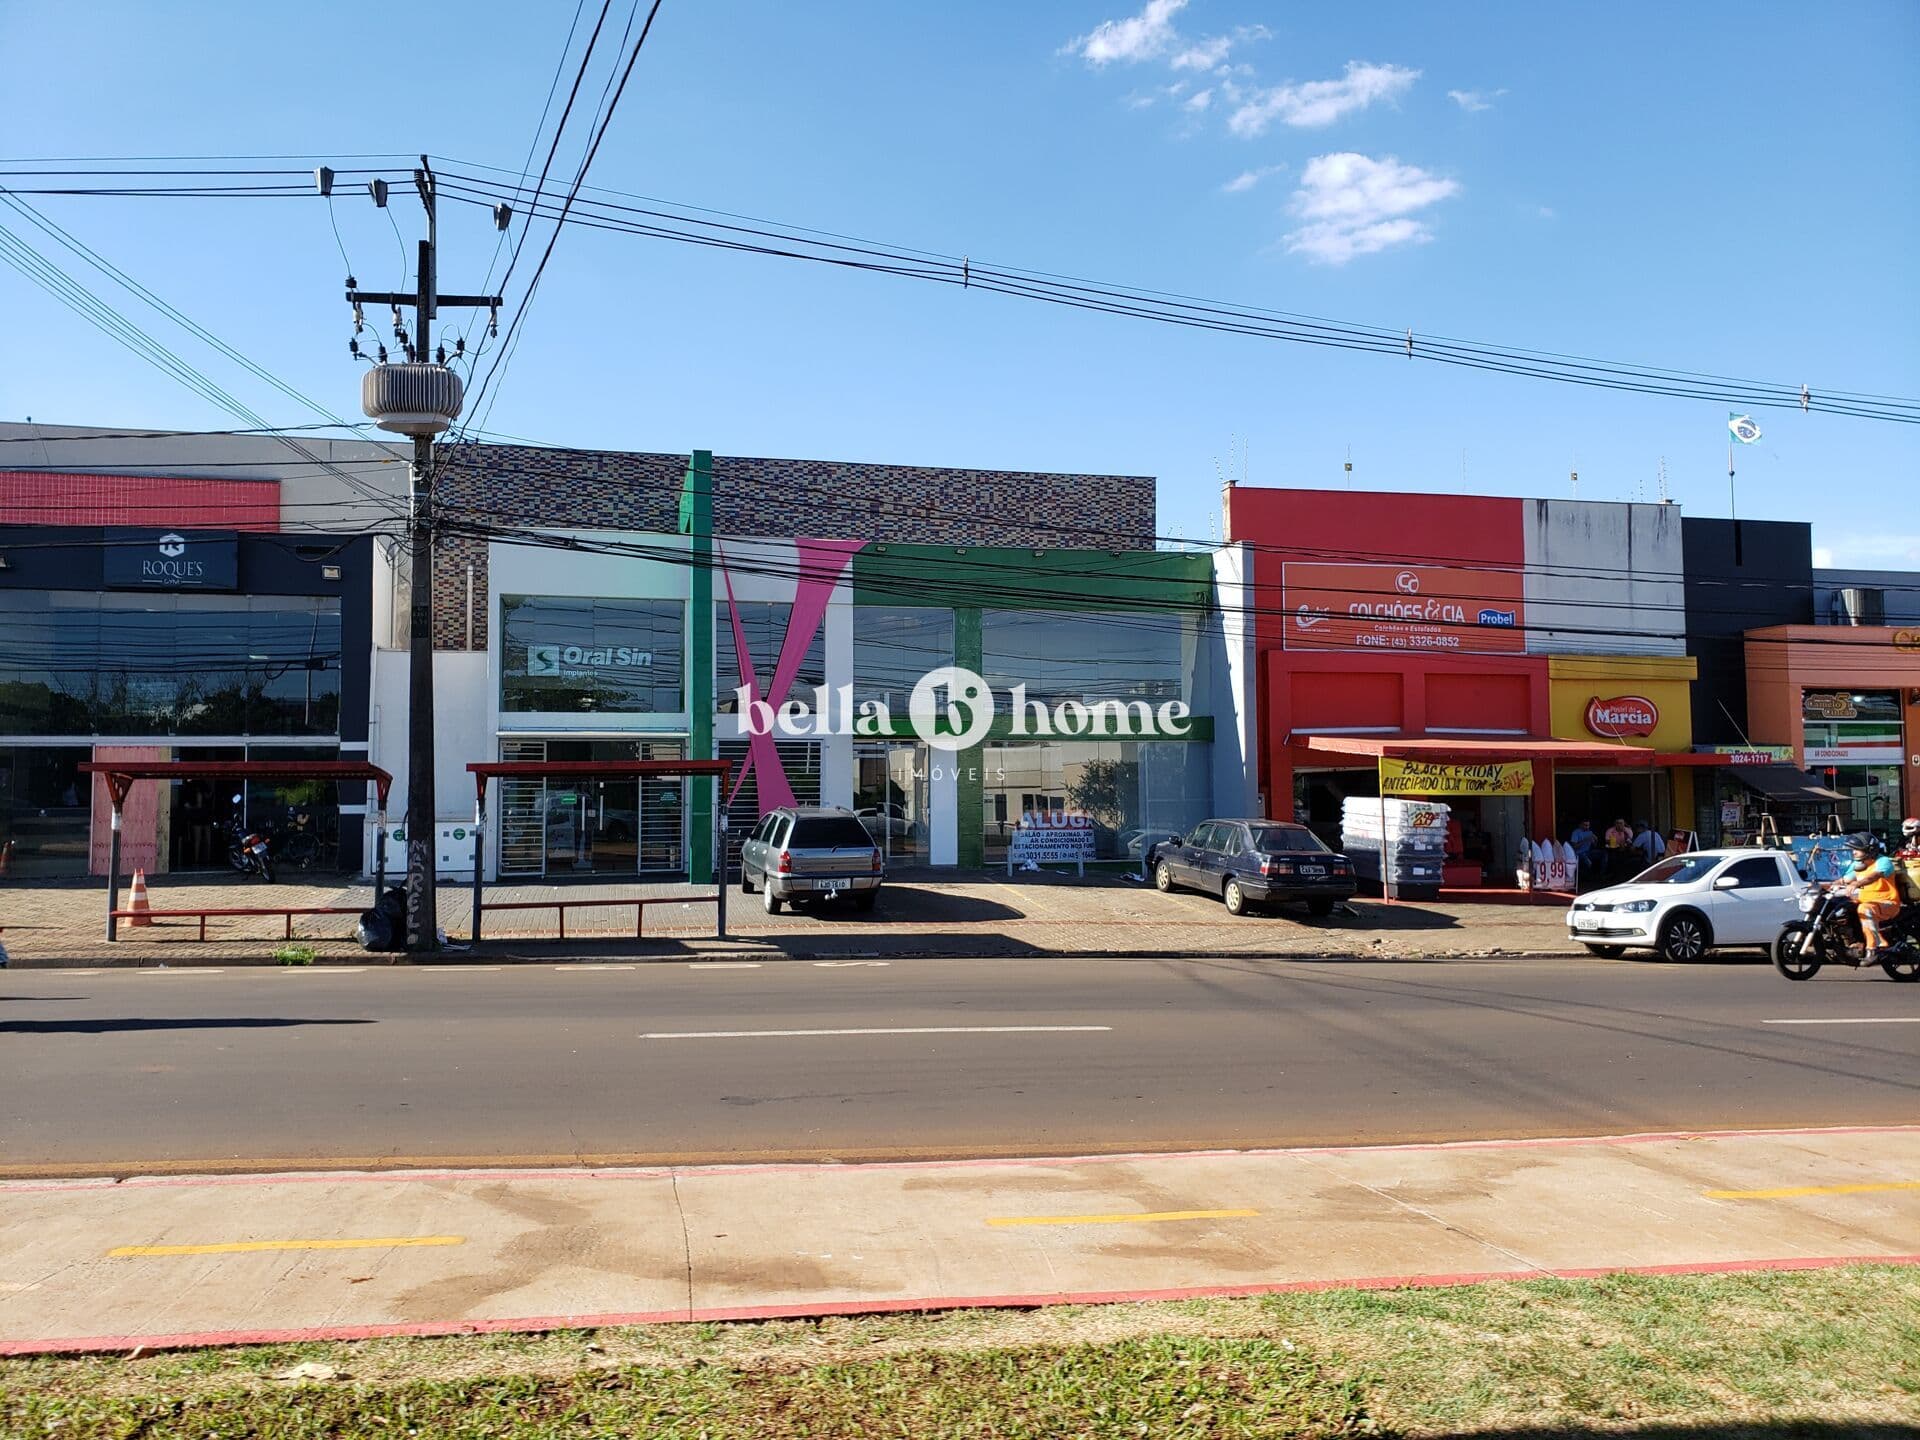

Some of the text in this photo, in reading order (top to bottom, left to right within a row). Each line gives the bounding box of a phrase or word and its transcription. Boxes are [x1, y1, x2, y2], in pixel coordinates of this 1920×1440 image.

[143, 560, 203, 578] ROQUE'S
[1424, 598, 1440, 622] &
[1442, 605, 1466, 623] CIA
[1480, 612, 1513, 625] Probel
[1356, 635, 1459, 648] FONE: (43) 3326-0852
[563, 647, 652, 666] Oral Sin
[1731, 754, 1769, 764] 3024-1717
[1403, 762, 1503, 781] BLACK FRIDAY
[1383, 776, 1439, 791] ANTECIPADO
